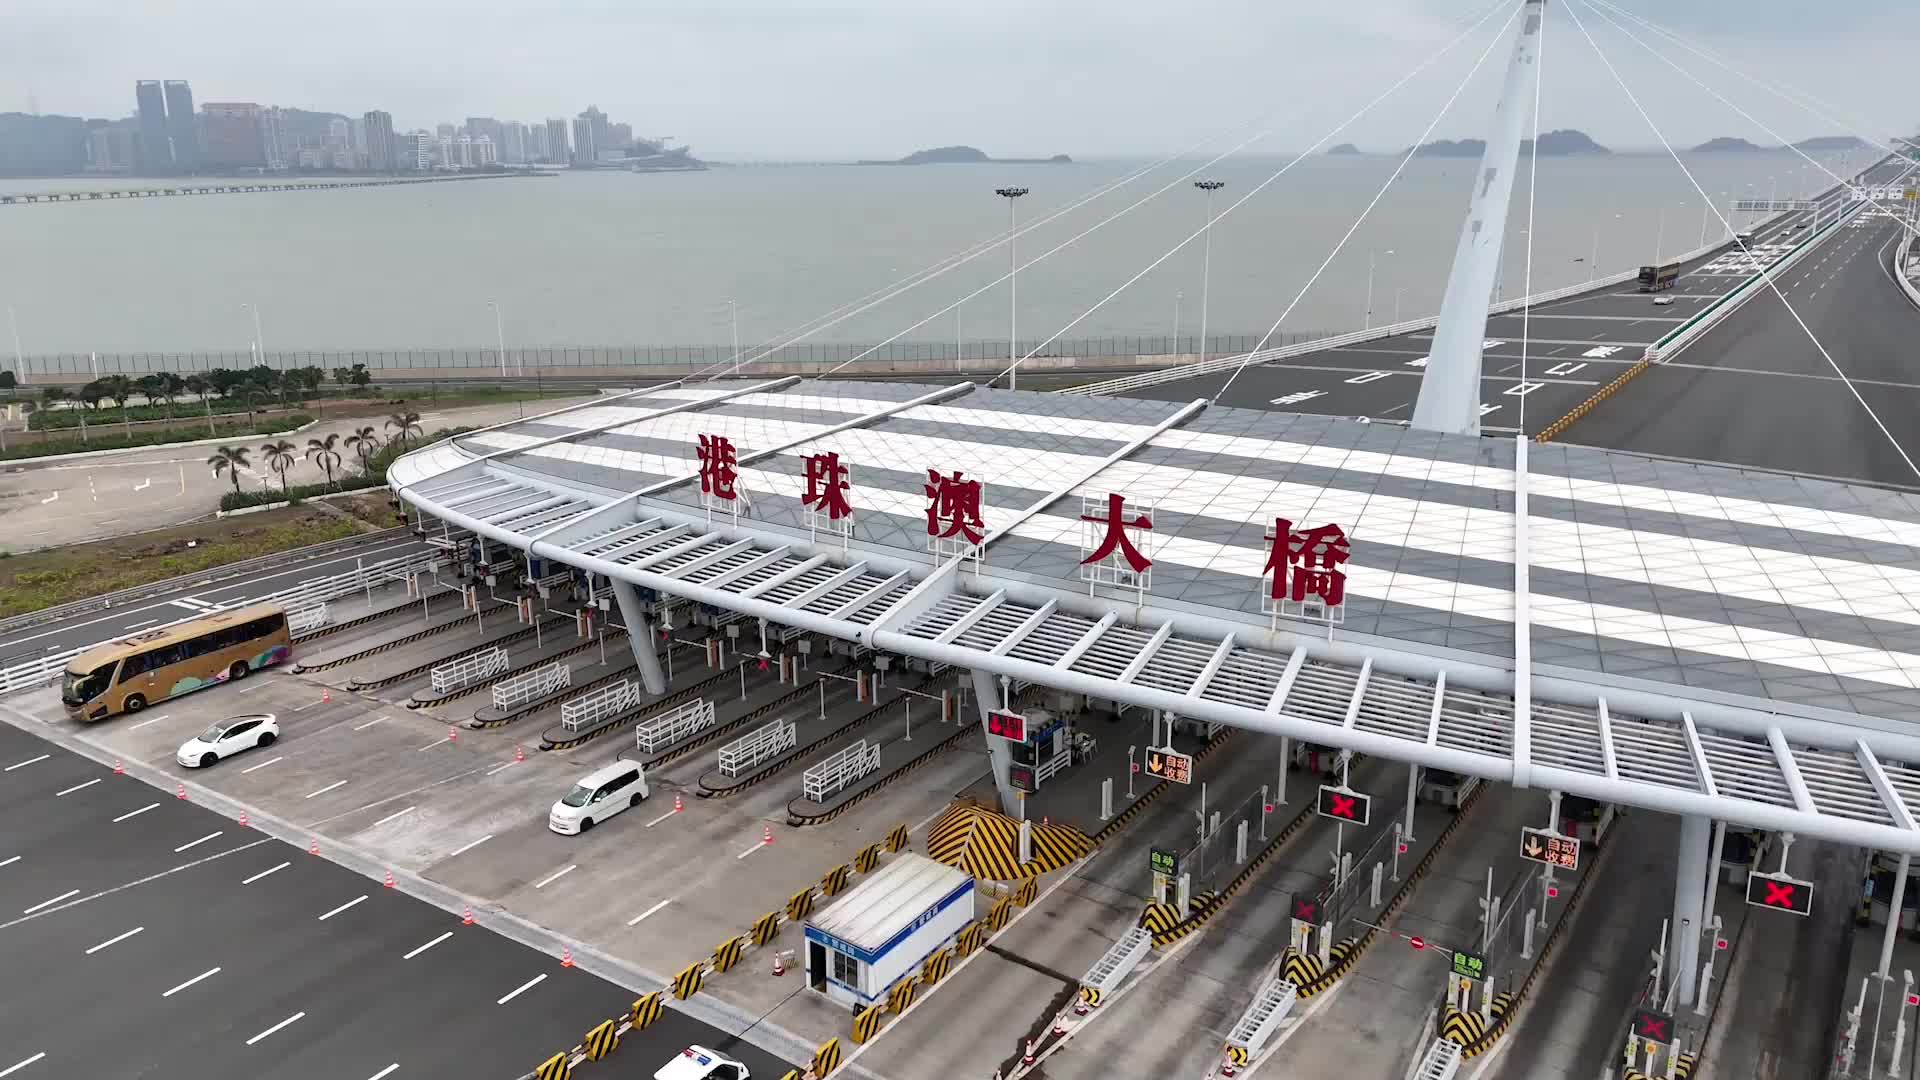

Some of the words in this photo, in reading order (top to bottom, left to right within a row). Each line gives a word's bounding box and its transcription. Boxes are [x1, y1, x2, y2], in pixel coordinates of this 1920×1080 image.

[697, 434, 1349, 607] 港珠澳大橋
[1547, 838, 1577, 855] 自动
[1152, 852, 1174, 868] 自动
[1545, 850, 1576, 868] 收费
[1455, 952, 1483, 971] 自动
